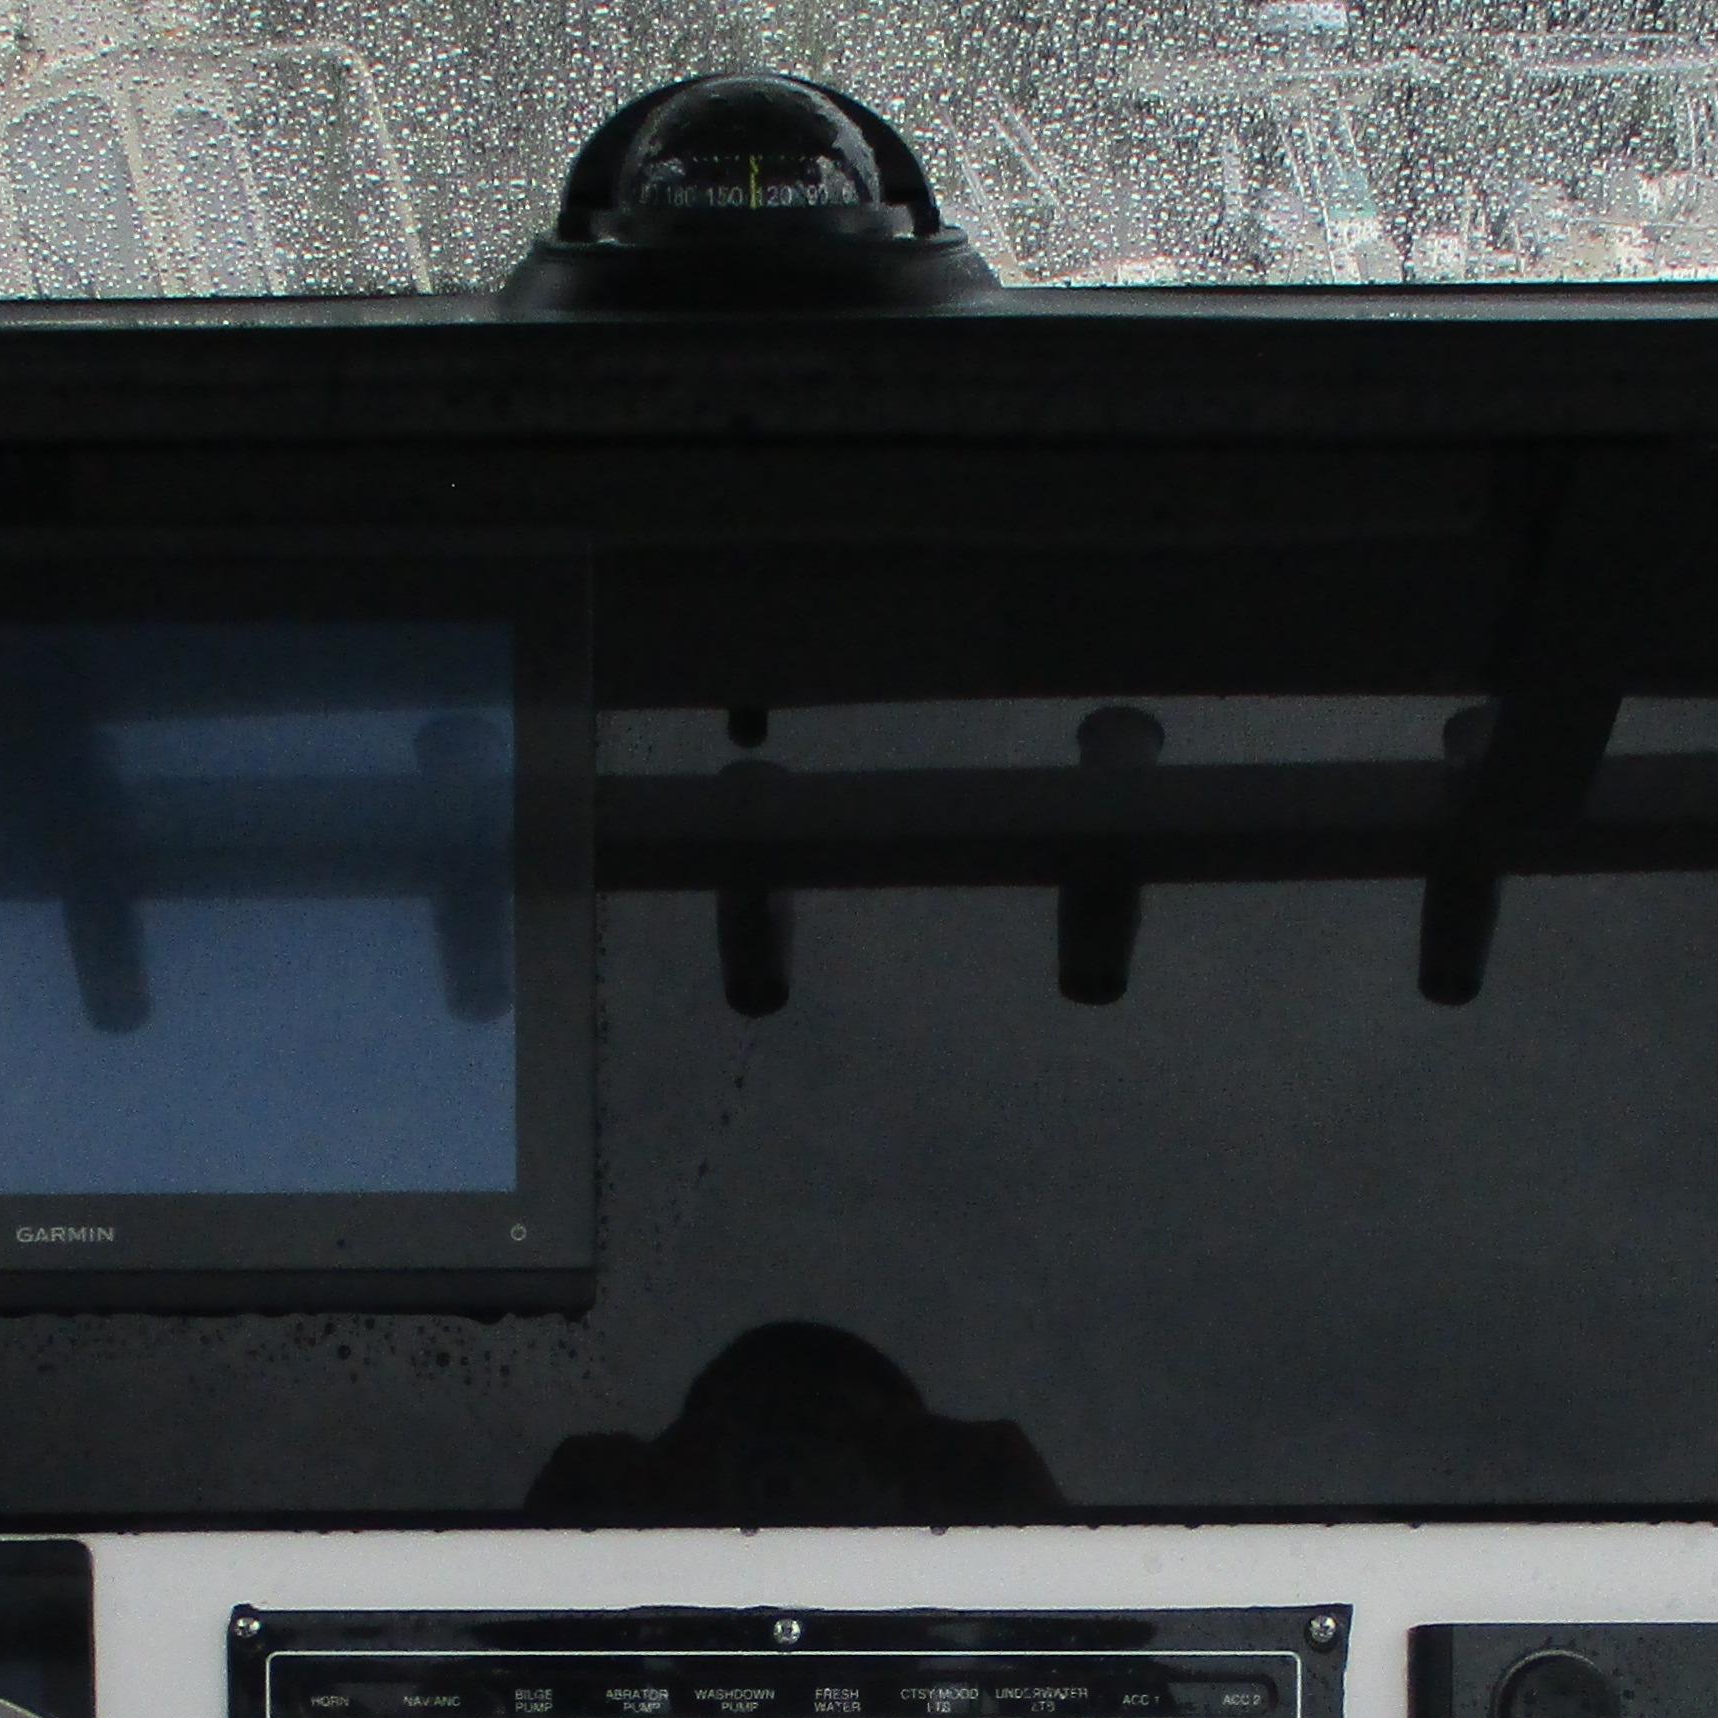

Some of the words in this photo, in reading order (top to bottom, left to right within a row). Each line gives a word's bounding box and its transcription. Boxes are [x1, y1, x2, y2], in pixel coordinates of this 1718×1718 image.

[16, 1226, 115, 1243] GARMIN
[514, 1688, 553, 1700] BILGE
[694, 1688, 775, 1700] WASHDOWN
[815, 1688, 859, 1700] FRESH
[900, 1688, 935, 1700] CTSY
[939, 1688, 979, 1700] MOOD
[995, 1687, 1088, 1700] UNDERWATER
[310, 1695, 350, 1707] HORN
[1122, 1694, 1149, 1706] ACC
[1221, 1694, 1250, 1706] ACC
[1252, 1694, 1262, 1706] 2
[515, 1702, 554, 1713] PUMP
[722, 1702, 759, 1713] PUMP
[814, 1702, 861, 1713] WATER
